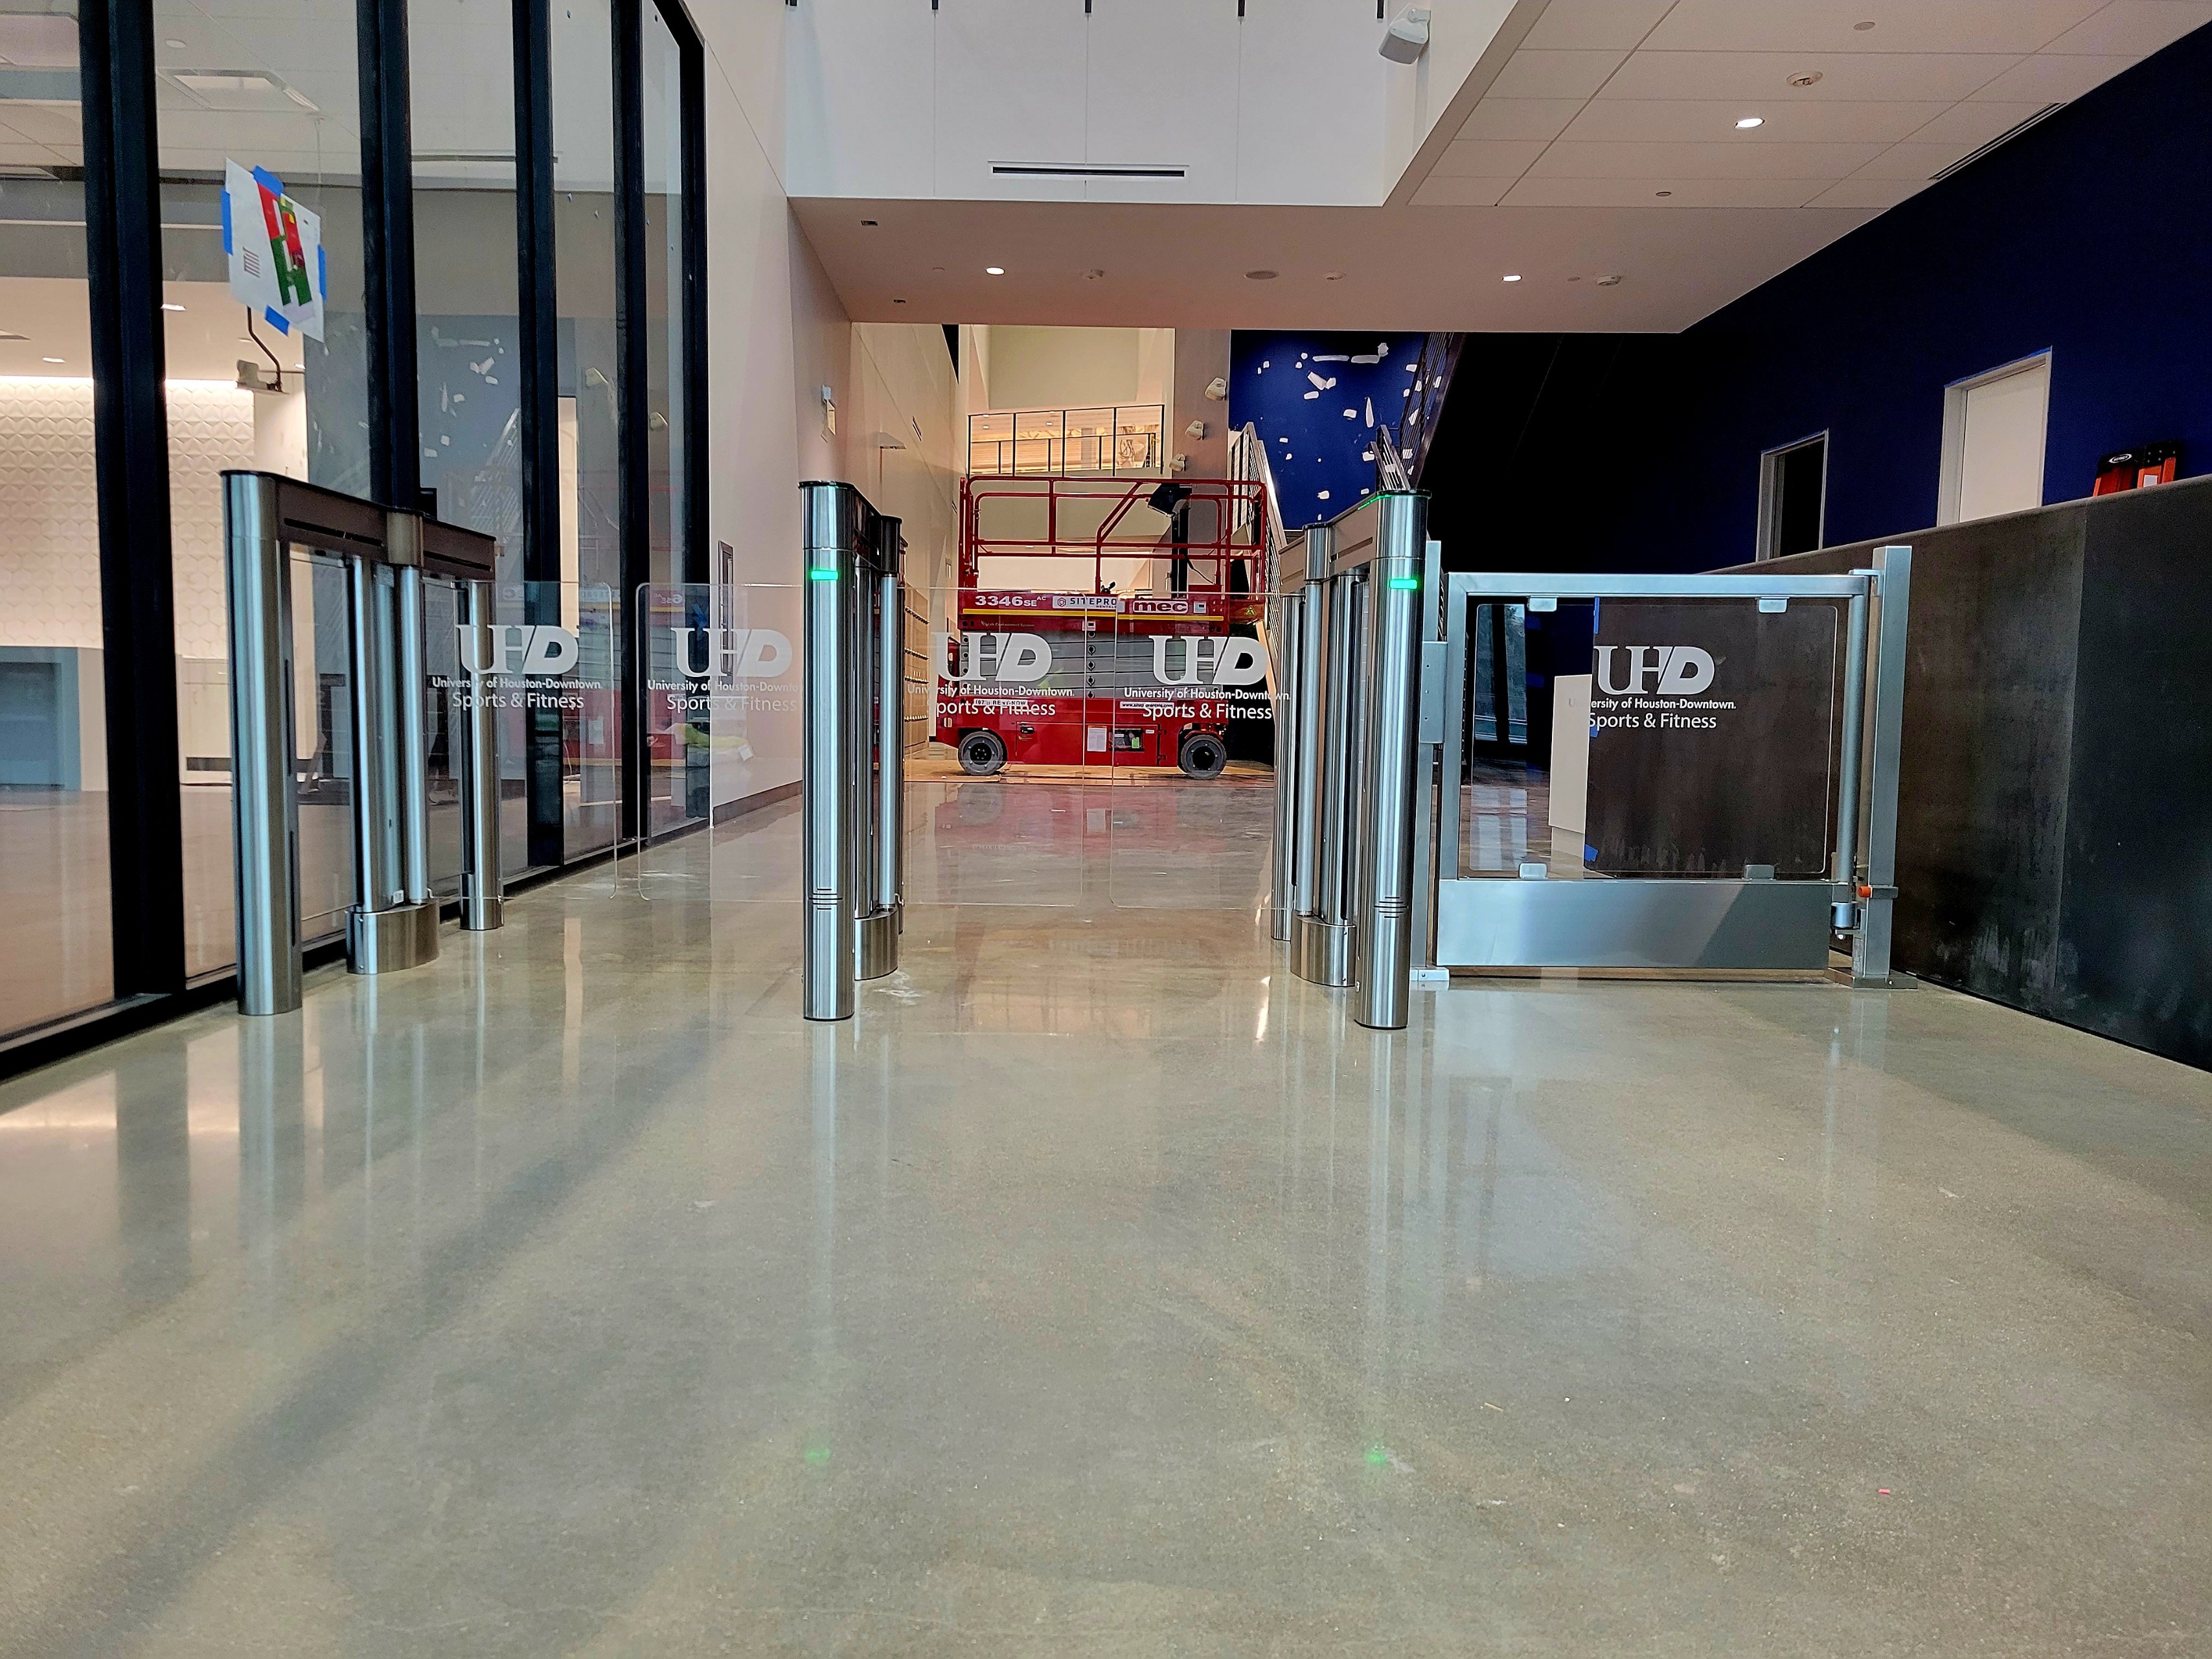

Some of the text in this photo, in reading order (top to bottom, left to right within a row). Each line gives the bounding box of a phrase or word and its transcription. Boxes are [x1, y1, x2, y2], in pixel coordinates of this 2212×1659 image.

[1070, 597, 1117, 606] SITEPRO
[1134, 601, 1187, 612] mec
[455, 624, 578, 674] UHD
[670, 628, 792, 678] UHD
[931, 632, 1053, 681] UHD
[1148, 635, 1268, 685] UHD
[1593, 645, 1715, 695] UHD
[432, 676, 483, 692] Universy
[486, 676, 498, 689] of
[648, 680, 700, 694] University
[908, 684, 1075, 698] Univrsity of Houston-Downtown.
[453, 691, 584, 711] Sports & Fitness
[1124, 687, 1174, 702] University
[1178, 687, 1189, 699] of
[1621, 696, 1633, 709] of
[1634, 698, 1737, 710] Houston-Downtown.
[667, 695, 797, 714] Sports & Fitness
[933, 699, 979, 717] ports
[1143, 703, 1272, 721] Sports & Fitness
[1643, 712, 1656, 729] &
[1660, 713, 1717, 729] Fitness
